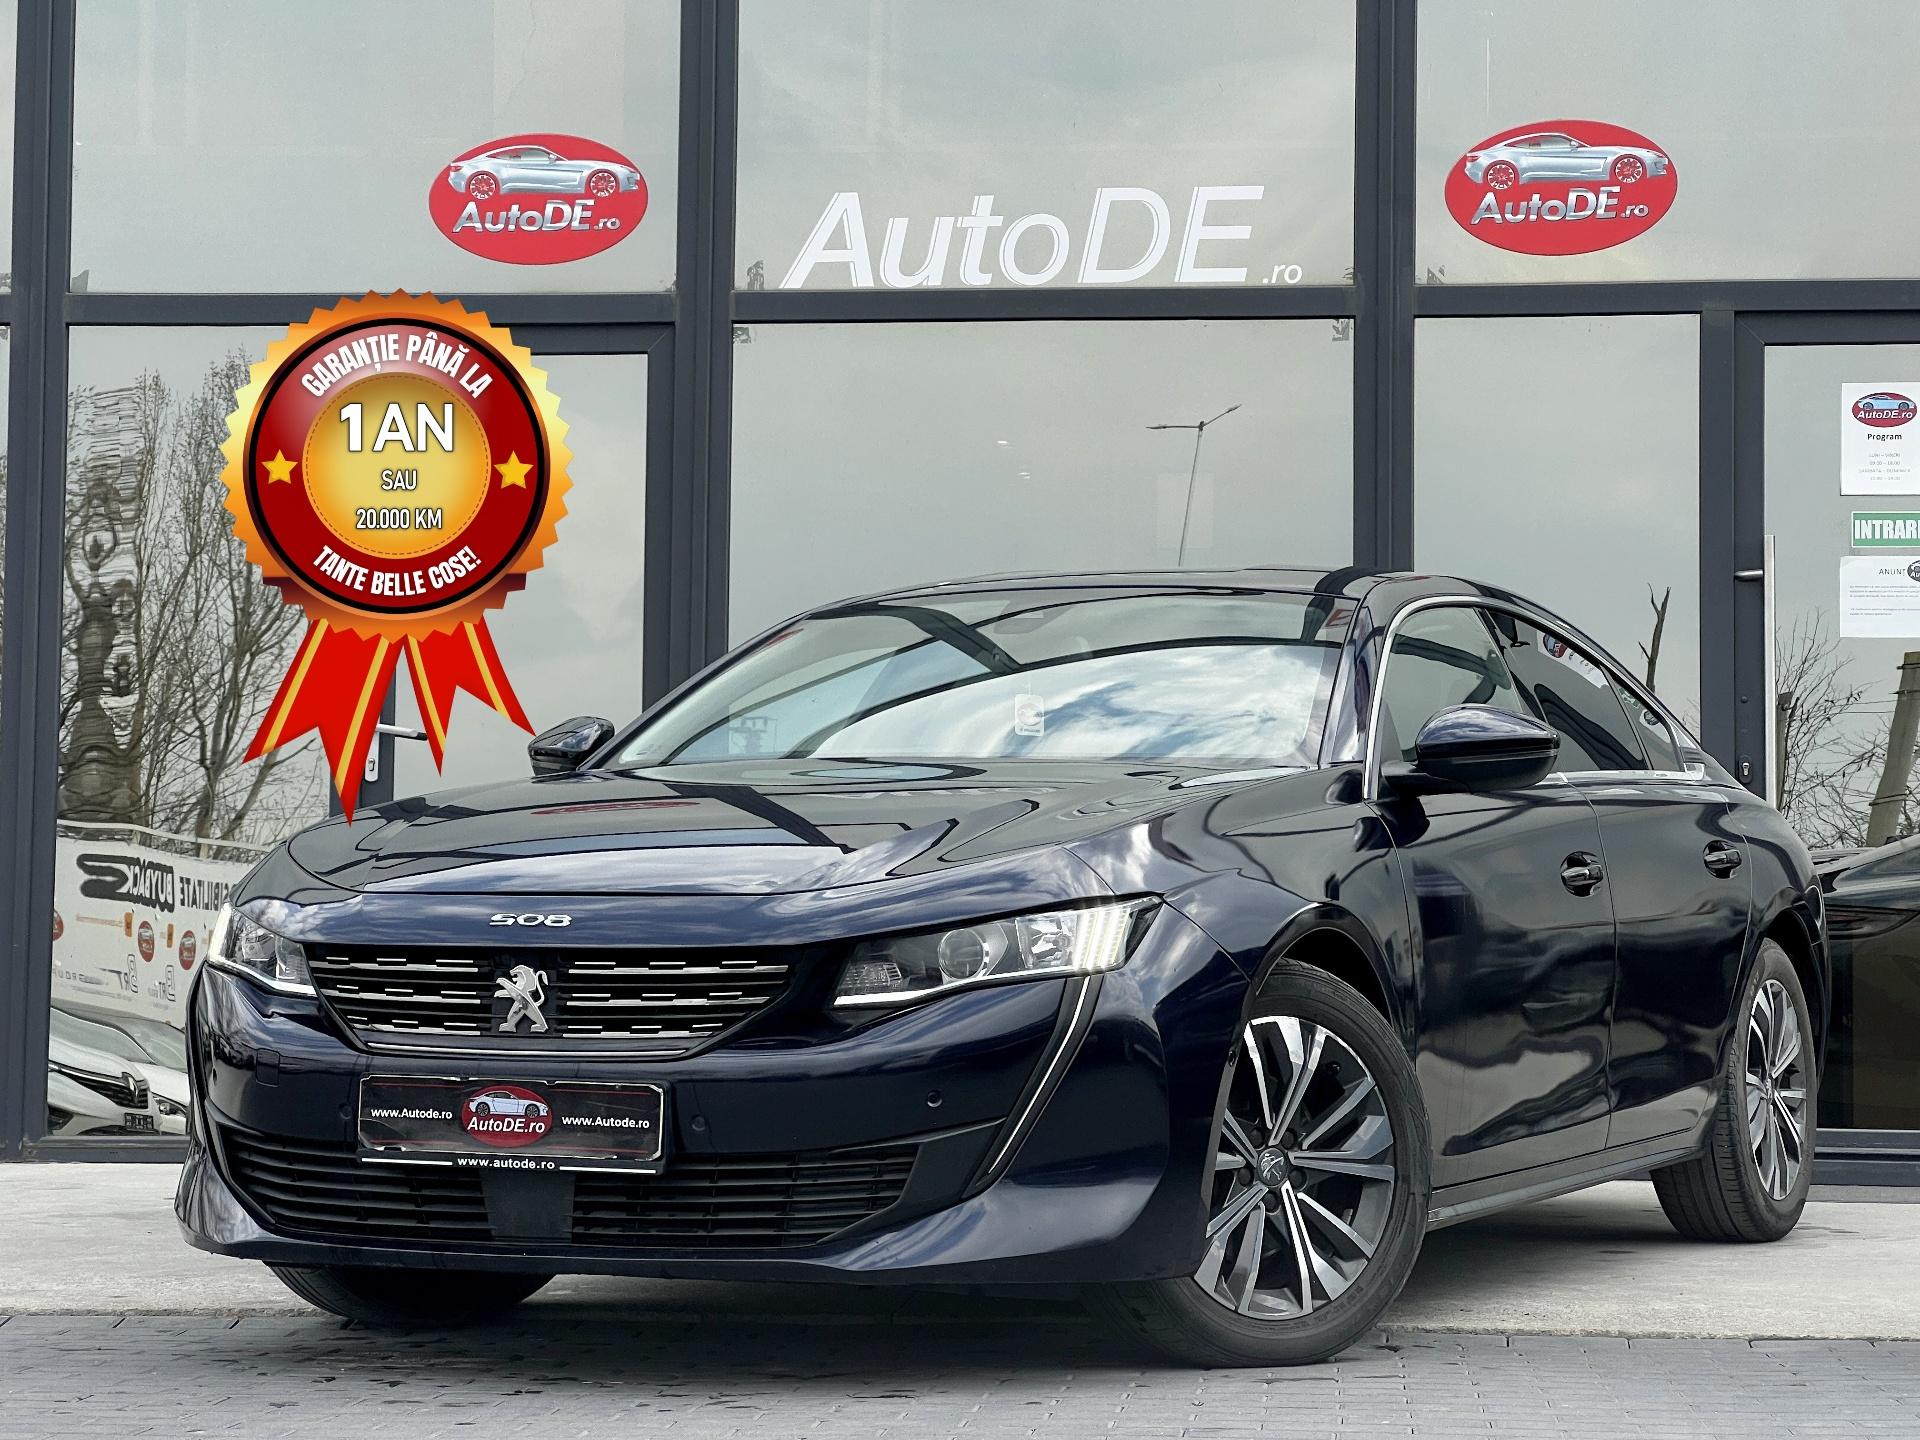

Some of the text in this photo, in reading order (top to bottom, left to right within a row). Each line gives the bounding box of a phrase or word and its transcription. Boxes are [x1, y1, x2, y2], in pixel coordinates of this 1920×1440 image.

[1470, 185, 1650, 226] AutoDE.ro
[451, 199, 622, 234] AutoDE.ro
[1856, 410, 1913, 419] AutoDE.ro
[1867, 433, 1903, 442] Program
[1854, 519, 1920, 540] INTRAR
[489, 913, 573, 927] 508
[370, 1107, 453, 1120] www.Autode.ro
[467, 1116, 546, 1134] AutoDE.ro
[561, 1114, 650, 1129] www.Autode.ro
[457, 1155, 556, 1170] www.autode.ro
